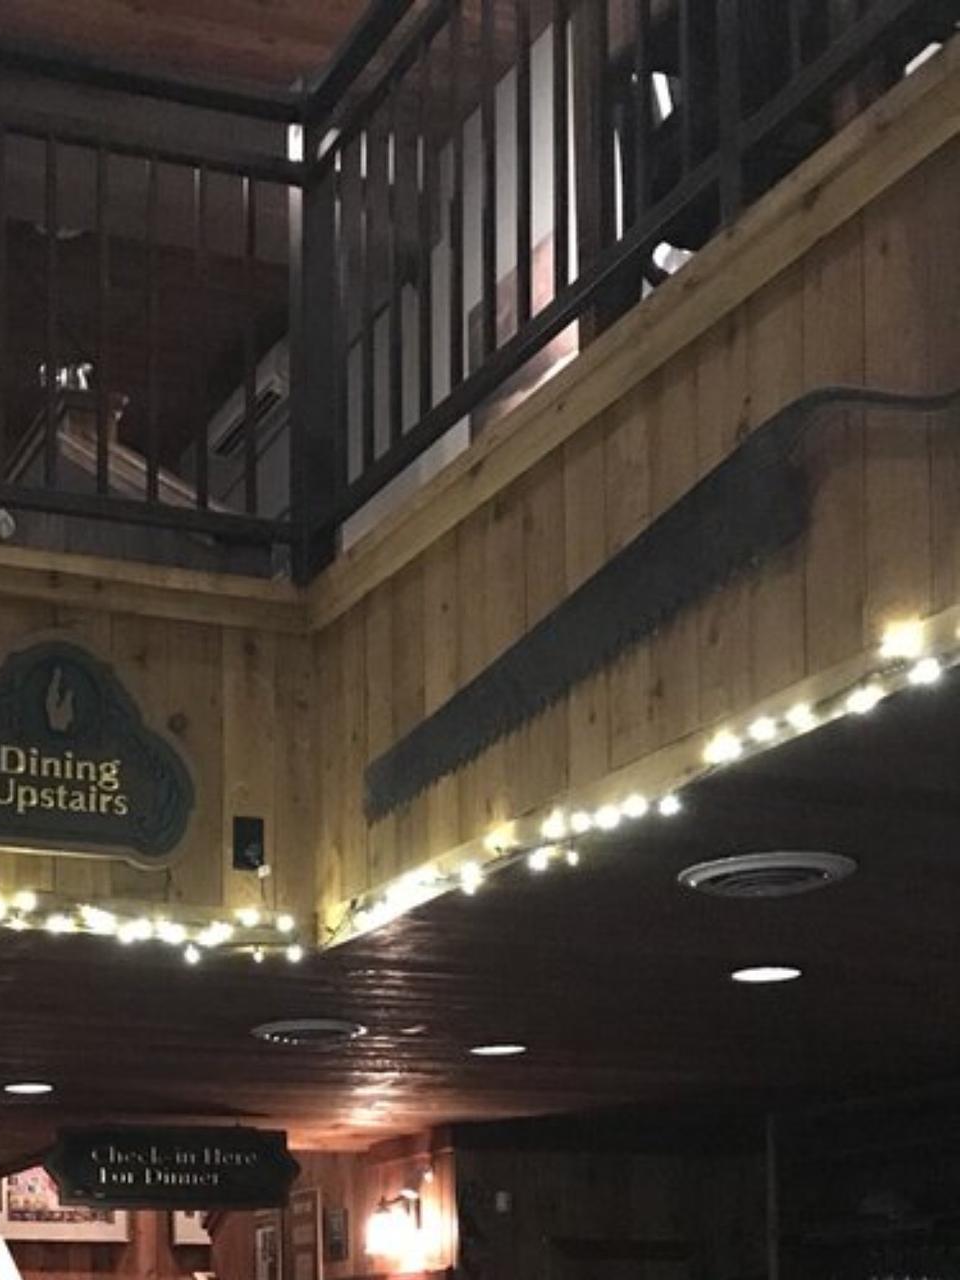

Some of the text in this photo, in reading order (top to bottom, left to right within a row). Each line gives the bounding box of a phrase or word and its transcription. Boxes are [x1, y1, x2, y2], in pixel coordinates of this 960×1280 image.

[0, 745, 121, 791] Dining
[204, 1148, 257, 1167] Here
[145, 1167, 219, 1185] Dinner
